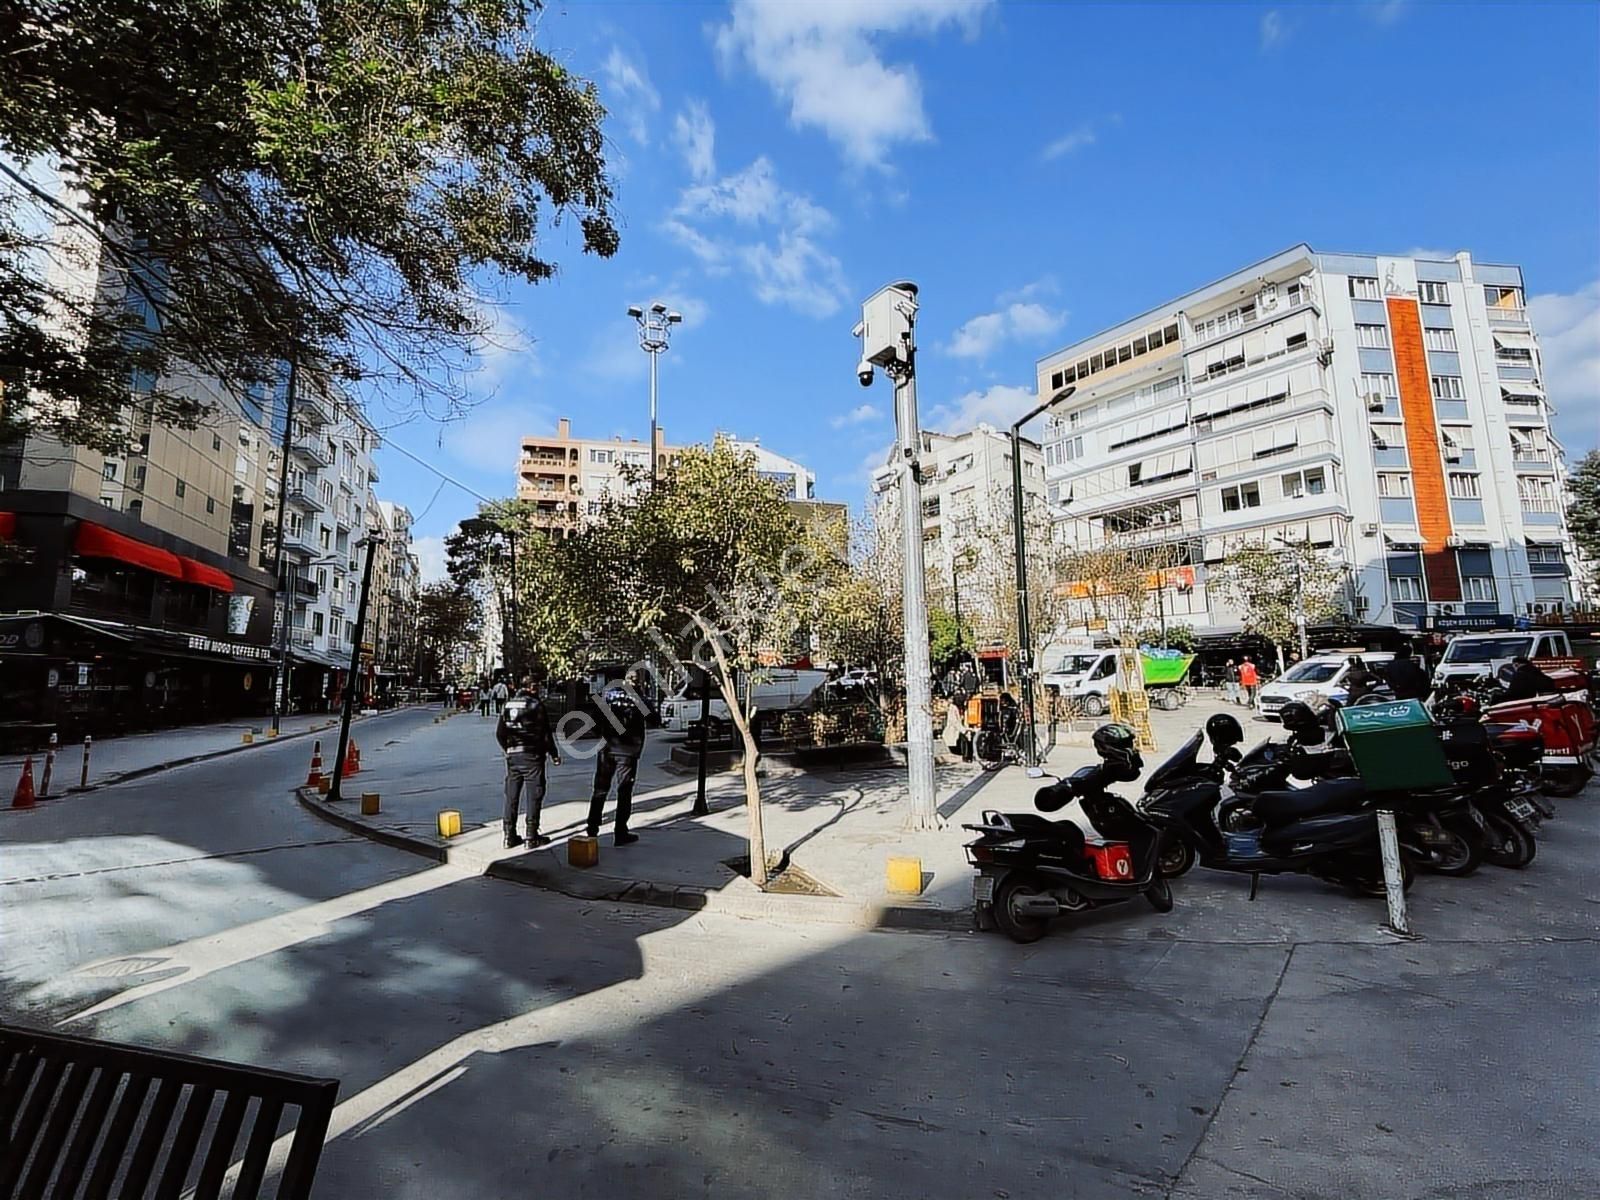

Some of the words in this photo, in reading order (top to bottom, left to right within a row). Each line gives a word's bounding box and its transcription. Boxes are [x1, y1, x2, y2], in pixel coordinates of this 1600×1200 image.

[188, 637, 211, 651] BREW
[211, 640, 231, 654] MOOD
[232, 644, 255, 657] COFFEE
